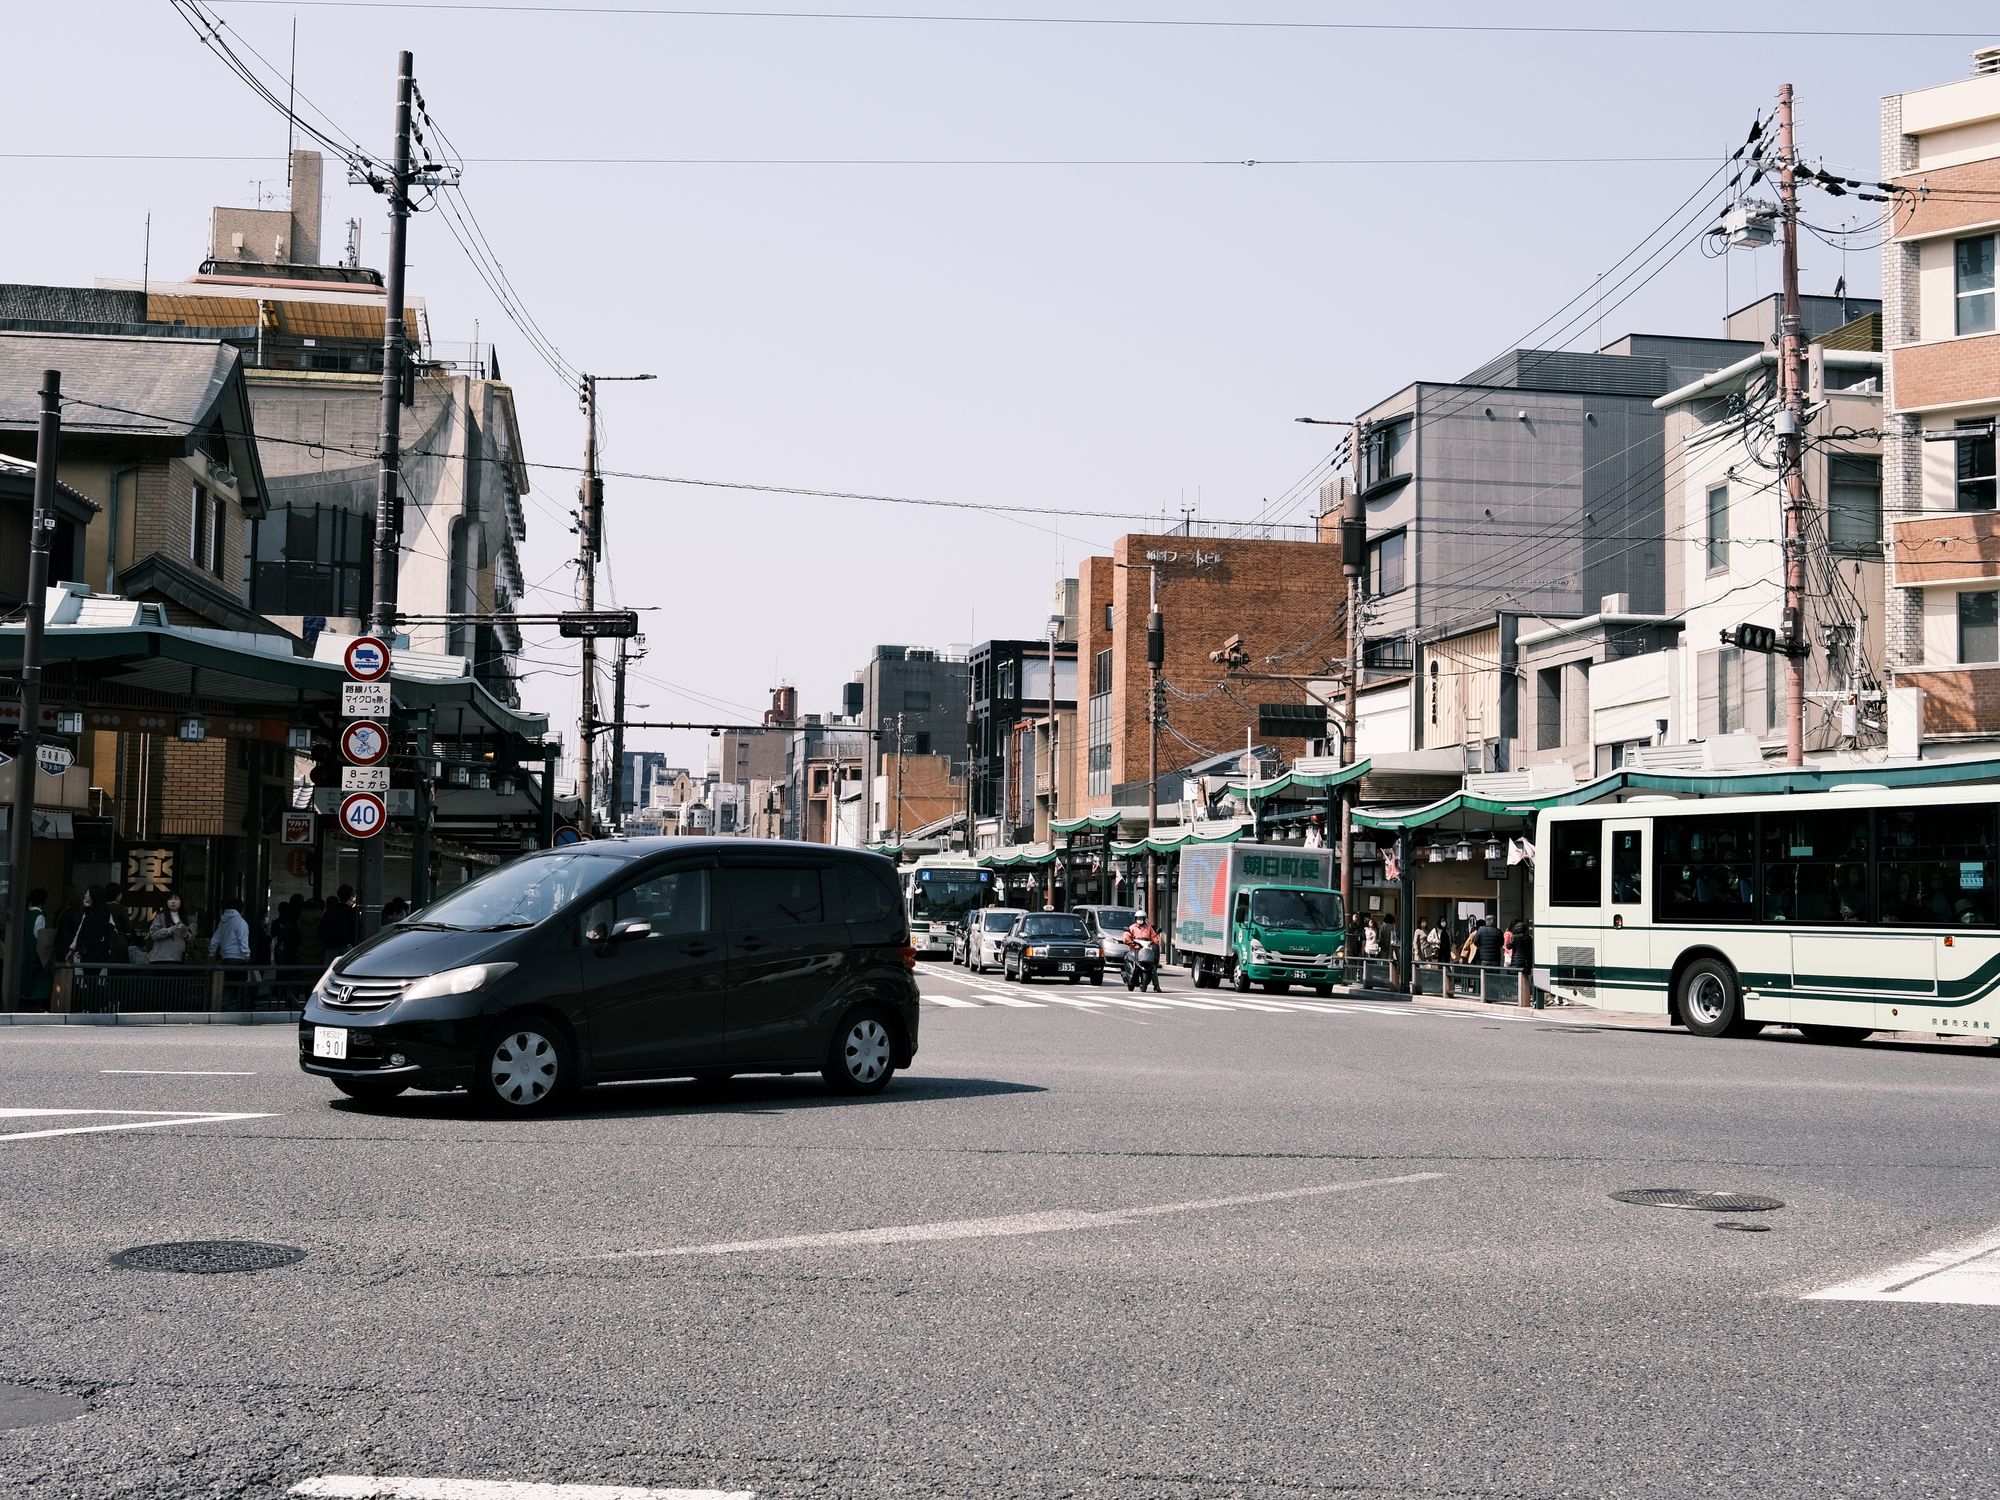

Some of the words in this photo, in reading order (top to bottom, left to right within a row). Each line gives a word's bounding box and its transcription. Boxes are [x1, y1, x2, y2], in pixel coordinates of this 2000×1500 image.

[345, 780, 388, 790] ここから
[350, 805, 376, 825] 40
[127, 848, 174, 892] 薬
[1243, 855, 1320, 879] 朝日町便
[1931, 1018, 1990, 1029] 京都市交通局
